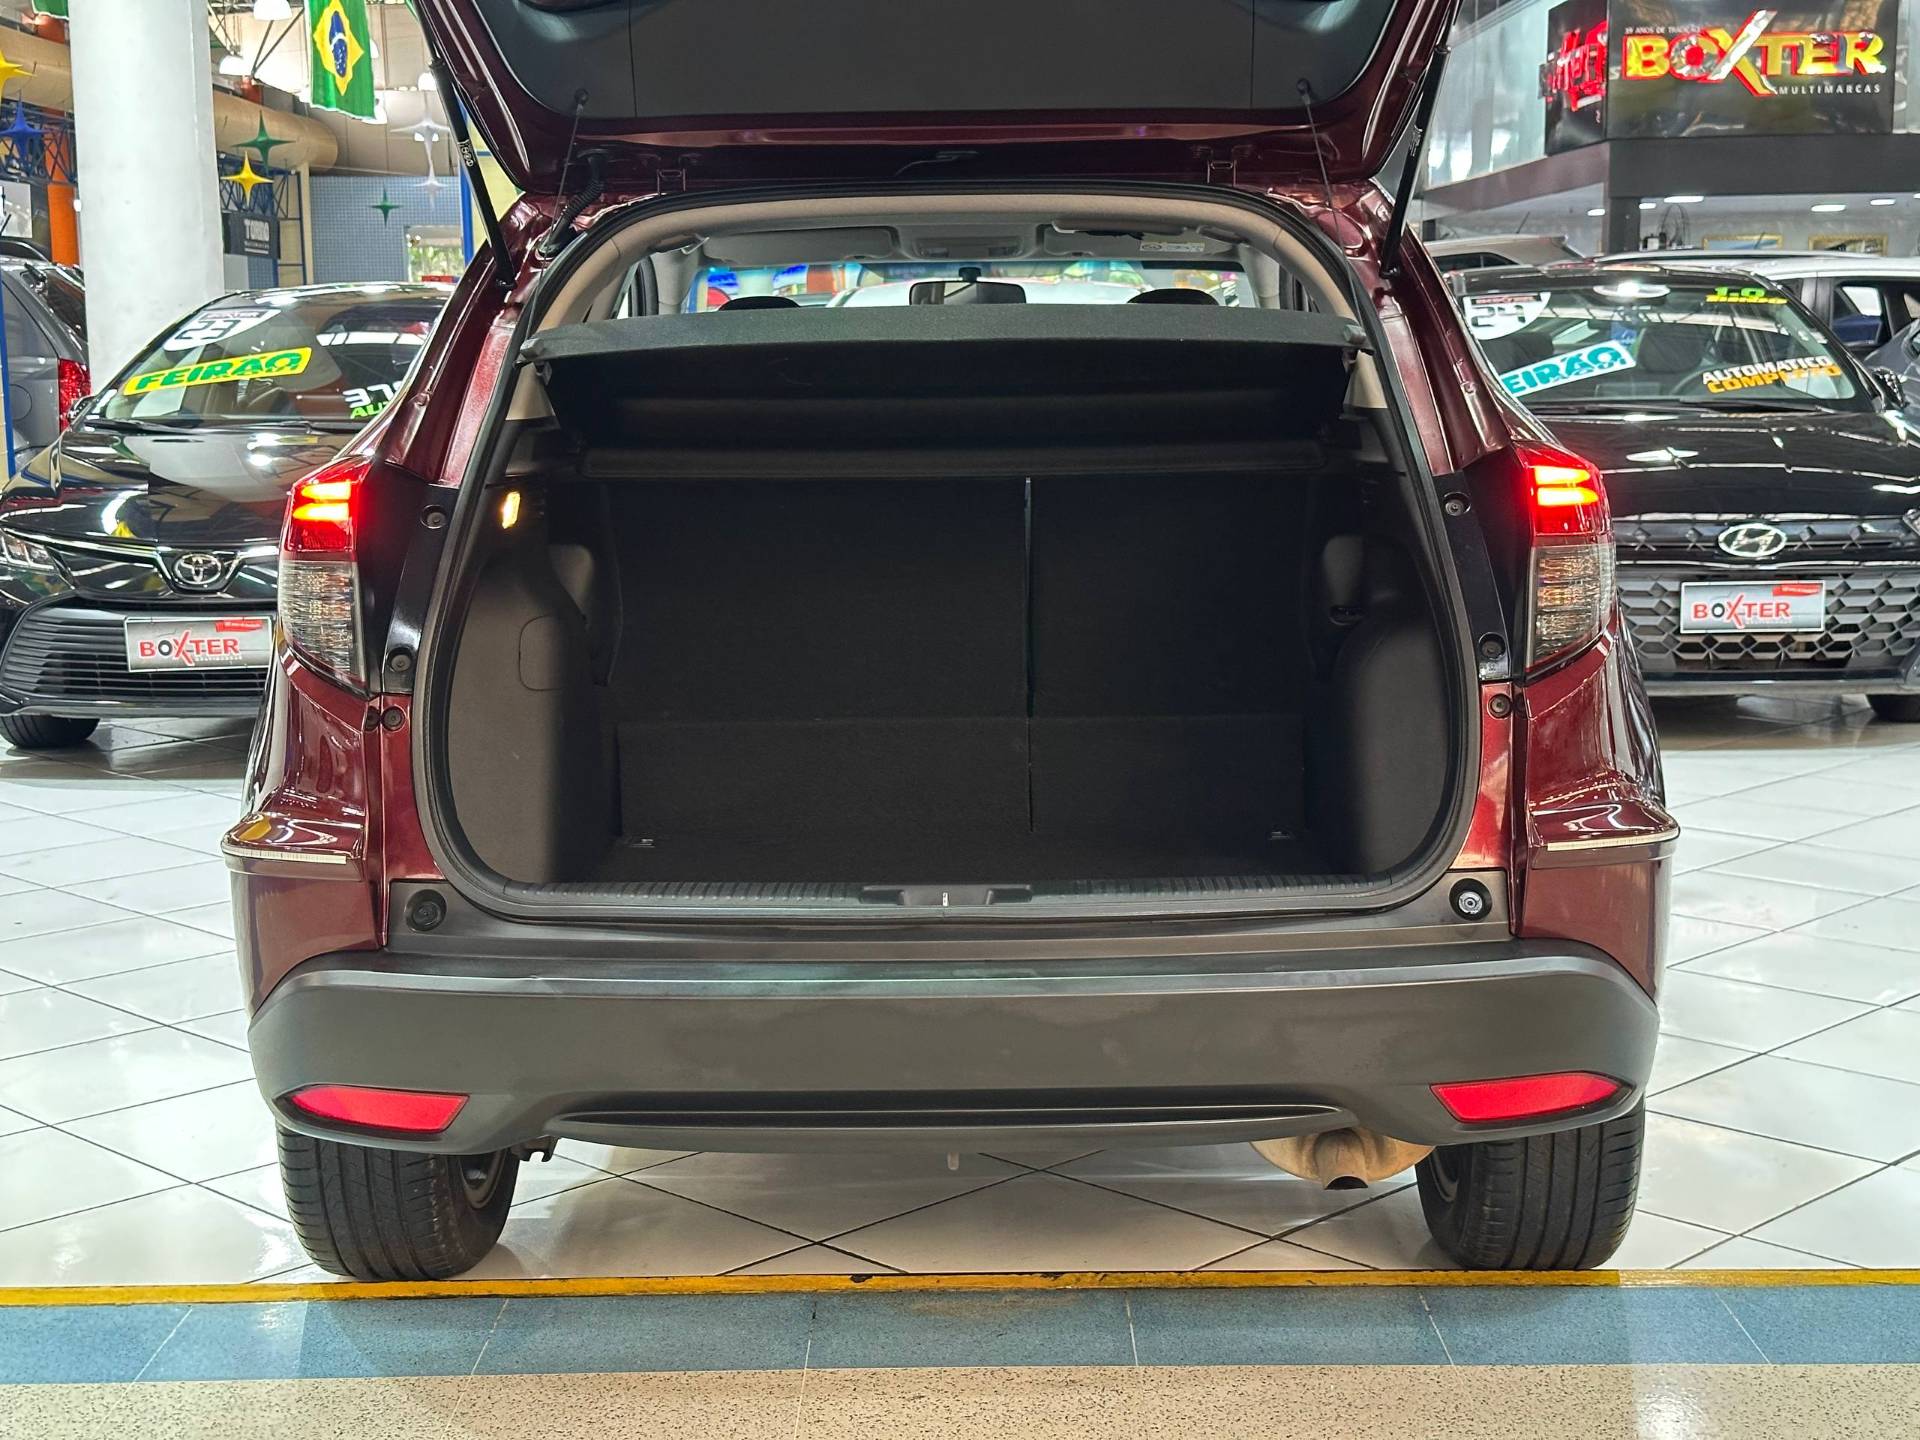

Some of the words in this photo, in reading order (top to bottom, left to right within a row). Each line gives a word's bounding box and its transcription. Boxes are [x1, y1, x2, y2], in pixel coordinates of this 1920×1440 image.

[1622, 9, 1887, 97] BOXTER
[1779, 83, 1881, 95] MULTIMARCAS
[1714, 286, 1766, 298] 1.0
[174, 319, 241, 341] 23
[1470, 304, 1526, 328] 24
[136, 352, 302, 391] FEIRÃO
[1501, 346, 1627, 394] EIRÃO
[1693, 594, 1791, 628] BOXTER
[140, 631, 239, 665] BOXTER
